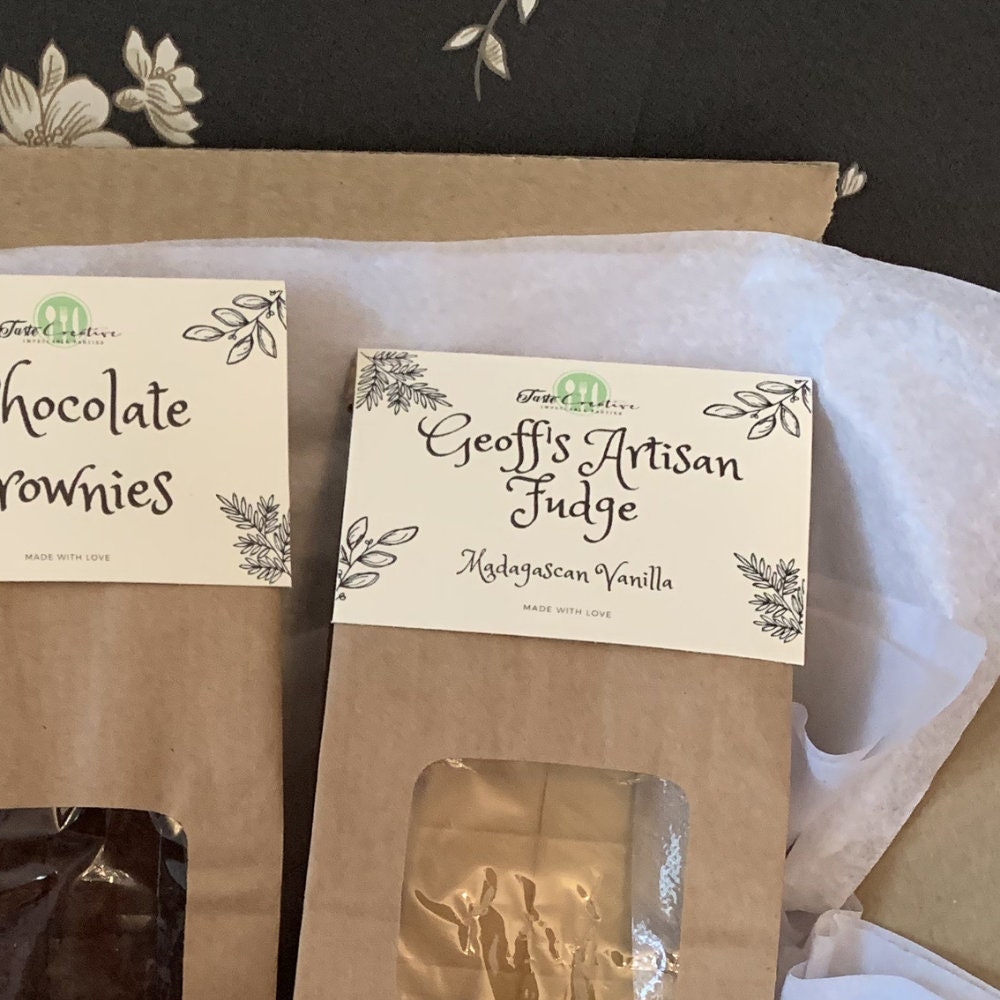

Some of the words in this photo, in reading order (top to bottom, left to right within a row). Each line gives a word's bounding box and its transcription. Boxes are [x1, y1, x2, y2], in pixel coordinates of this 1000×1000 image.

[516, 388, 561, 404] Taste
[417, 412, 571, 474] Geoff's
[577, 426, 744, 491] Artisan
[505, 472, 640, 543] Fudge
[24, 553, 54, 561] MADE
[56, 553, 82, 561] WITH
[85, 553, 111, 562] LOVE
[455, 548, 590, 588] Madagascan
[594, 560, 674, 592] Vanilla
[523, 604, 552, 613] MADE
[556, 607, 582, 615] WITH
[586, 609, 612, 619] LOVE
